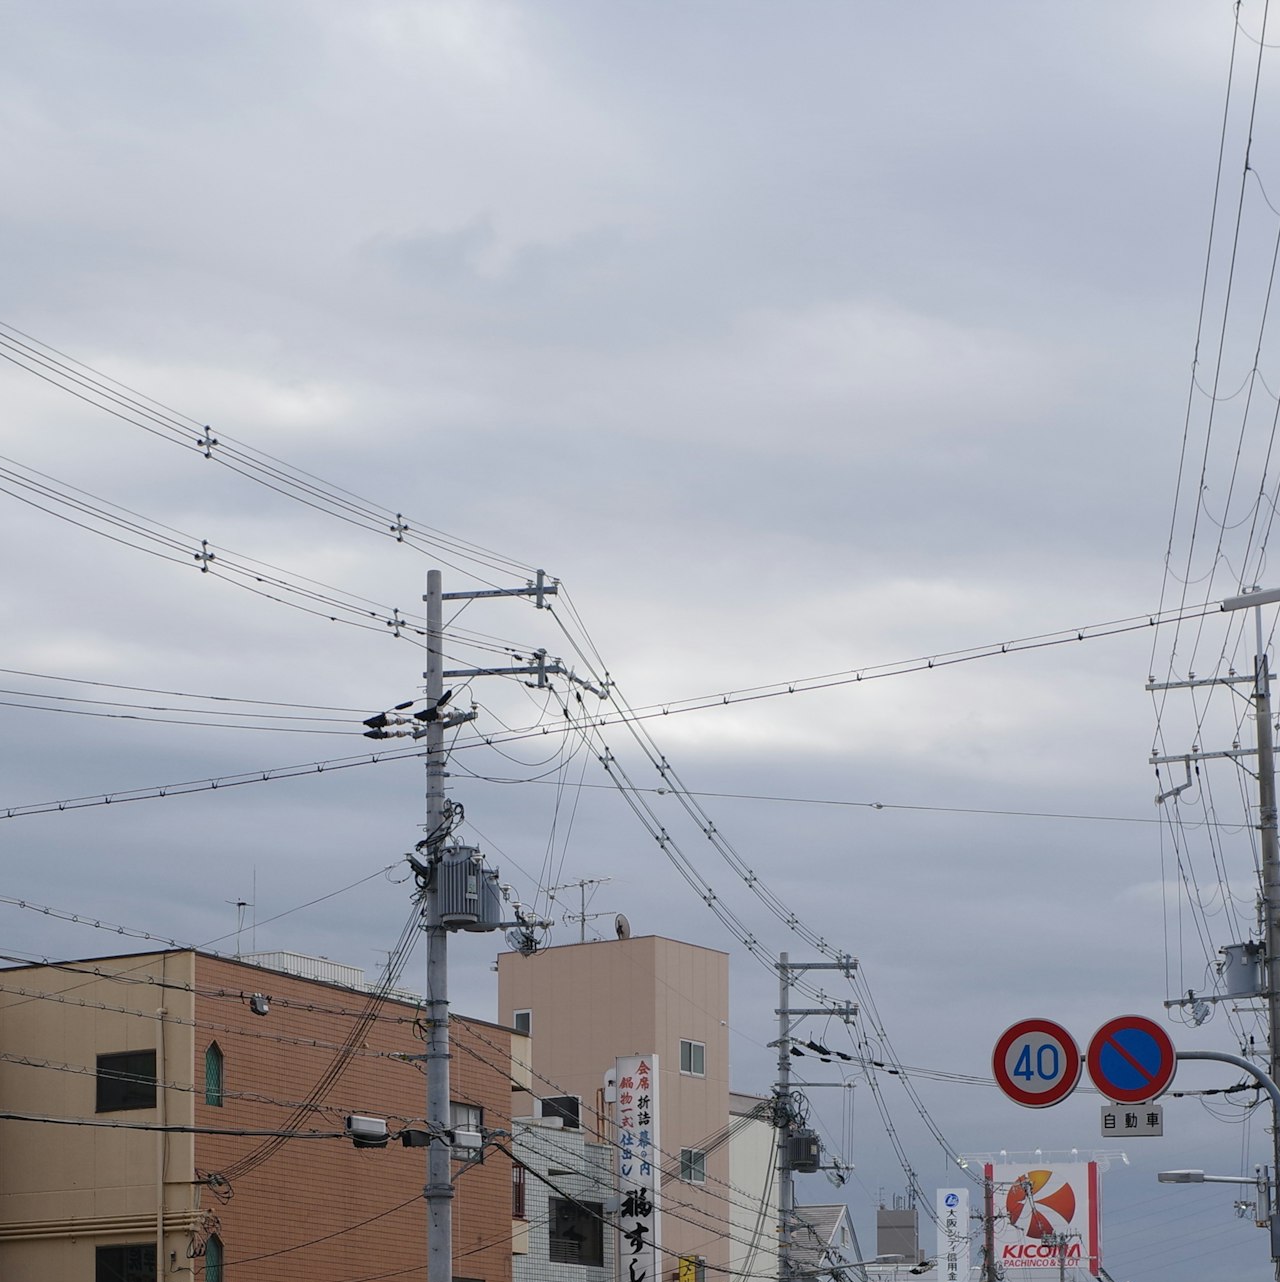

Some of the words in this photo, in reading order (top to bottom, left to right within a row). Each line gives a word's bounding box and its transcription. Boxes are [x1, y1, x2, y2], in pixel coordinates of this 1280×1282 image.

[636, 1060, 651, 1091] 会席
[1013, 1044, 1060, 1081] 40
[1104, 1112, 1160, 1129] 自動車
[620, 1132, 634, 1177] 仕出し
[1004, 1259, 1049, 1267] PACHINCO
